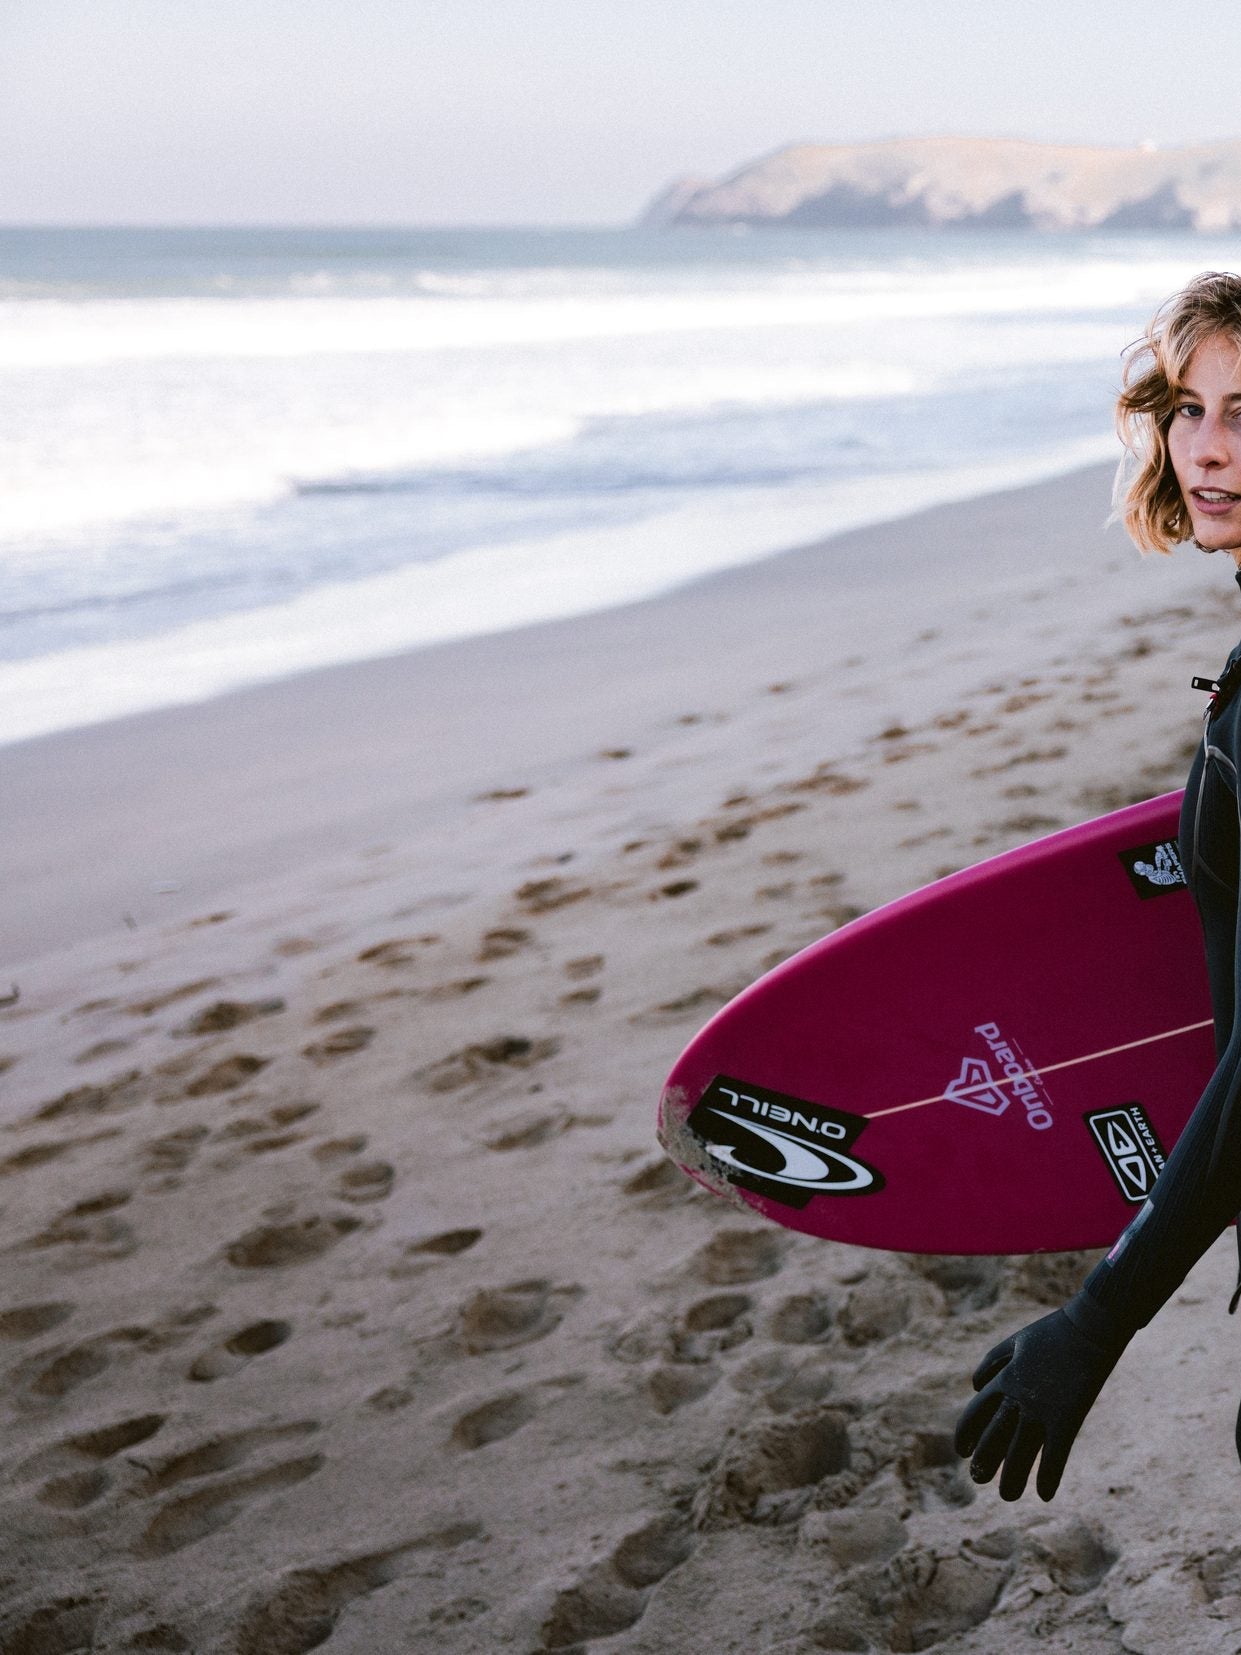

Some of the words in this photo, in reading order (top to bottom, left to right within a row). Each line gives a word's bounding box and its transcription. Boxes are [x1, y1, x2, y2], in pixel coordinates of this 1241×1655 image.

[974, 1022, 1053, 1130] Onboard
[718, 1087, 847, 1140] O'NEILL
[1130, 1106, 1156, 1146] EARTH
